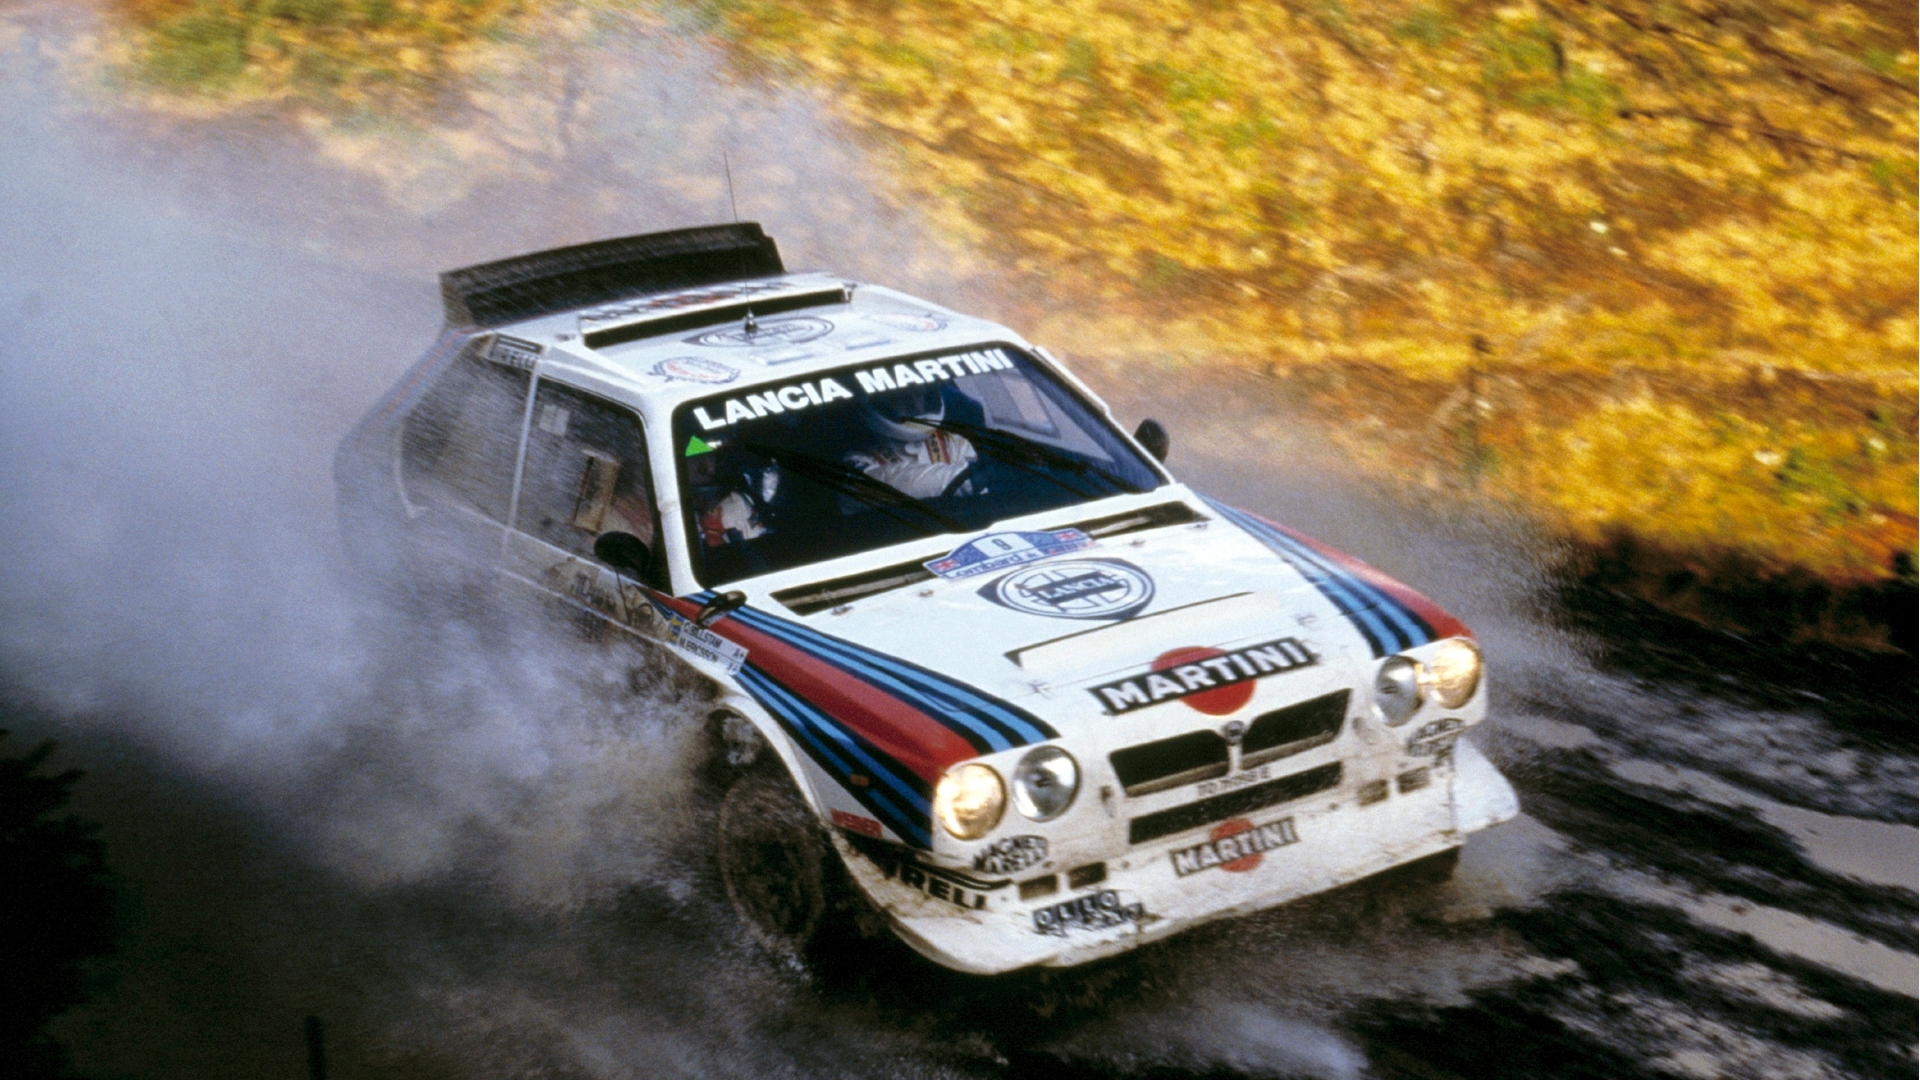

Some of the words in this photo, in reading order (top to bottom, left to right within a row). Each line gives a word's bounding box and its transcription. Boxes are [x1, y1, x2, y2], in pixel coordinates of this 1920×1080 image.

[693, 378, 852, 430] LANCIA
[855, 349, 1014, 394] MARTINI
[992, 538, 1012, 550] 9
[1038, 575, 1118, 600] LANCIA
[1100, 641, 1309, 711] MARTINI
[1174, 819, 1298, 876] MARTINI
